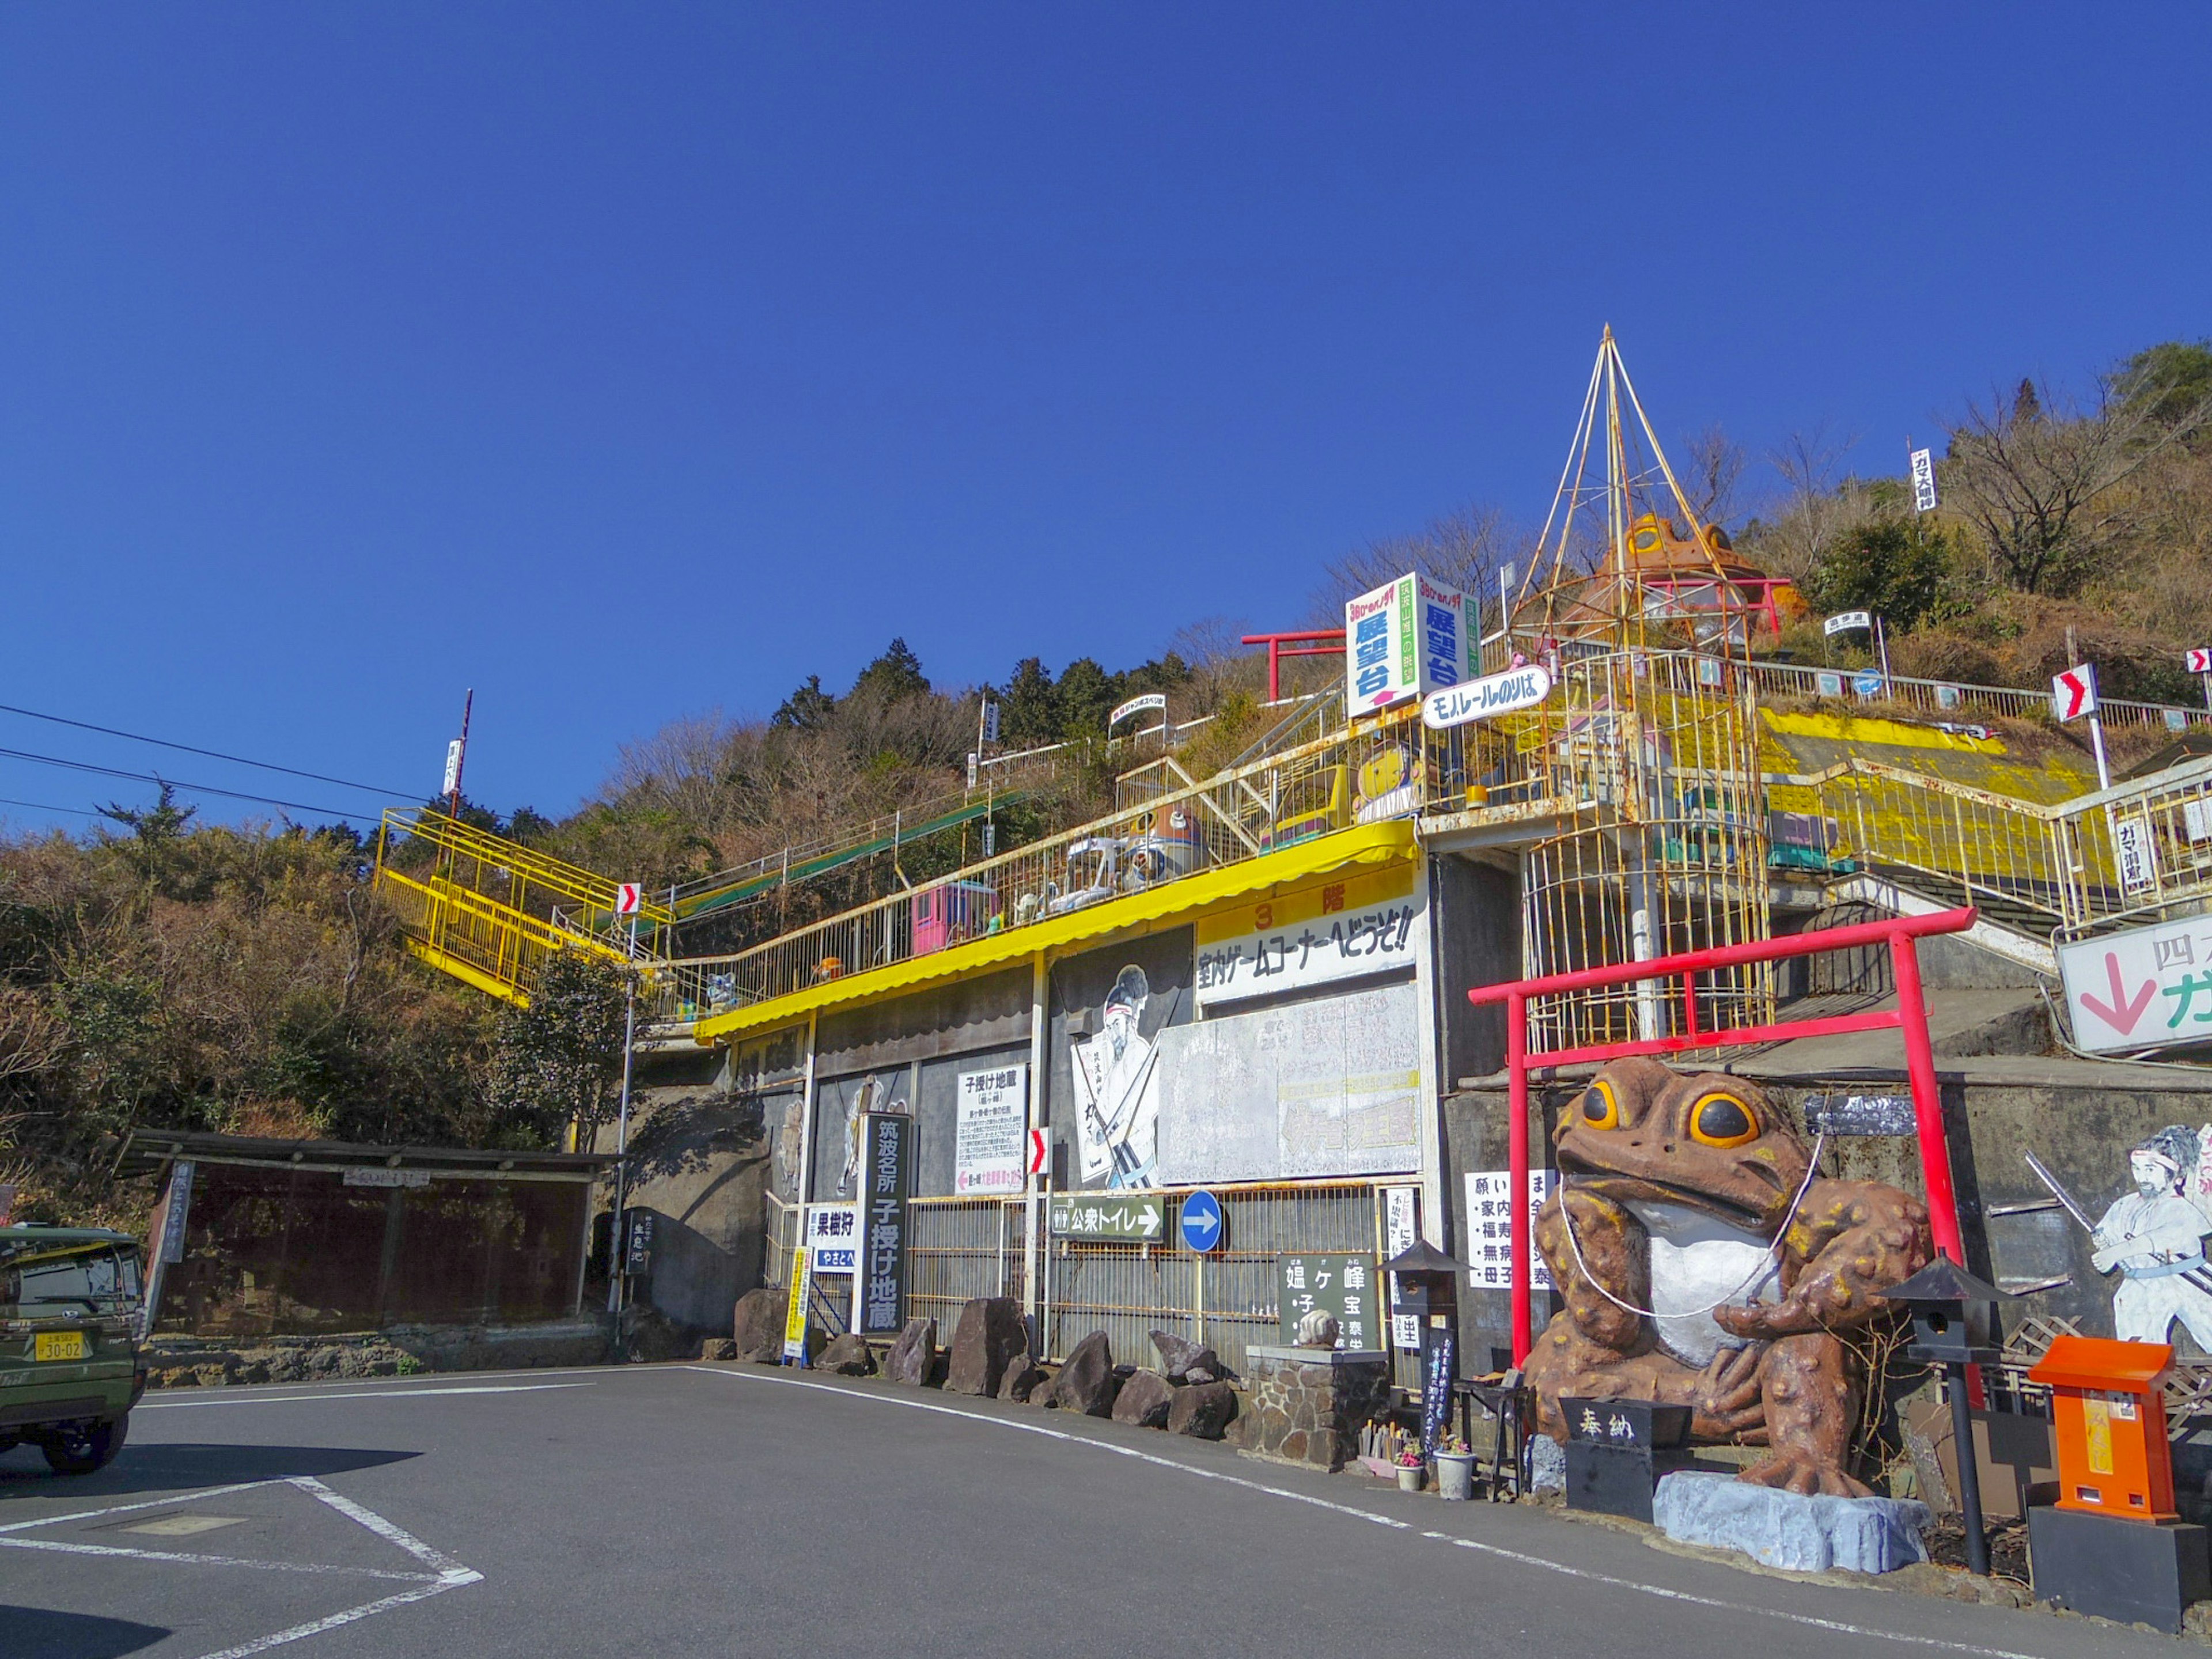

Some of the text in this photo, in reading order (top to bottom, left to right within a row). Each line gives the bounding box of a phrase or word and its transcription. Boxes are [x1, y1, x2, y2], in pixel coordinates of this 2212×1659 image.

[1915, 456, 1933, 509] ガマ大明神
[1356, 610, 1390, 698] 展望台
[1427, 603, 1459, 687] 展望台
[1433, 673, 1544, 720] モノレールのりば
[2153, 933, 2212, 972] 四
[965, 1069, 1017, 1093] 子授け地蔵
[868, 1120, 900, 1329] 筑波名所 子授け地蔵
[1071, 1206, 1137, 1233] 公衆トイレ
[1481, 1199, 1544, 1217] 家内全
[823, 1251, 855, 1266] やさとへ
[1484, 1266, 1550, 1285] 母子泰
[46, 1342, 80, 1358] 30-02
[1579, 1407, 1635, 1440] 奉納
